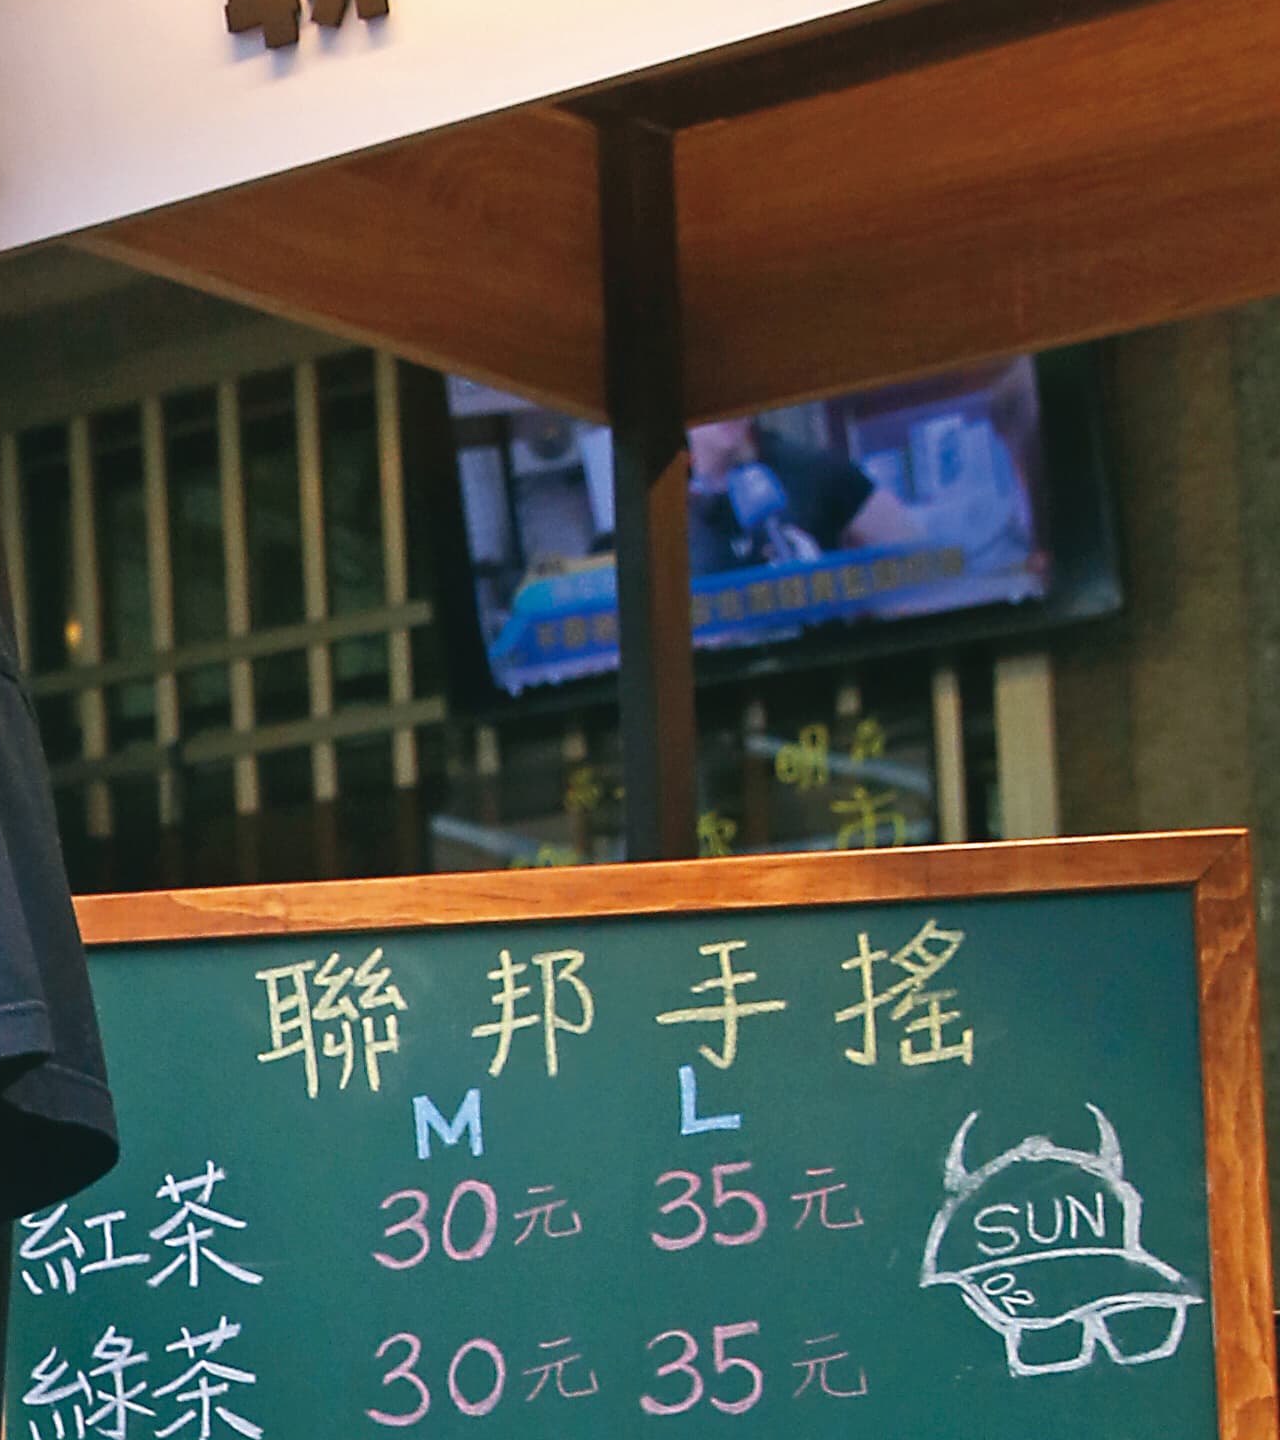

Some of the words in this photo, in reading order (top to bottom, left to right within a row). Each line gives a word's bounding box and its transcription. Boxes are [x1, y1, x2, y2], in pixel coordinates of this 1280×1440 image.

[255, 917, 977, 1099] 聯邦手搖
[413, 1088, 483, 1159] M
[678, 1065, 742, 1135] L
[20, 1160, 263, 1295] 紅茶
[973, 1191, 1106, 1257] SUN
